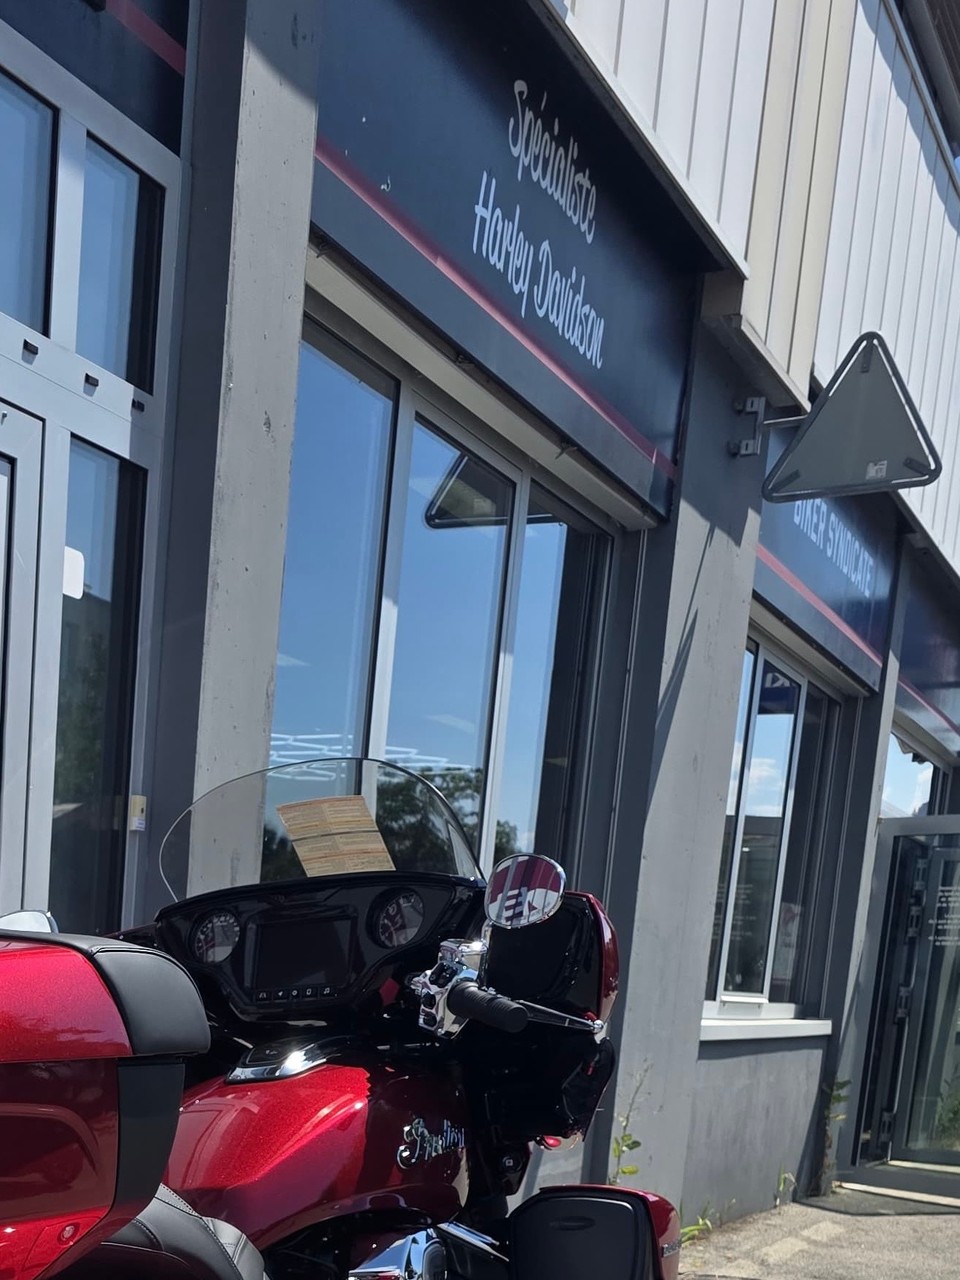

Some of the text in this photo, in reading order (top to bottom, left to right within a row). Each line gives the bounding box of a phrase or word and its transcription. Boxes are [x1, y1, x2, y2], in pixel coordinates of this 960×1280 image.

[508, 79, 597, 244] Spécialiste
[472, 170, 605, 370] Harley Davidson
[827, 513, 874, 598] SYNDICATE
